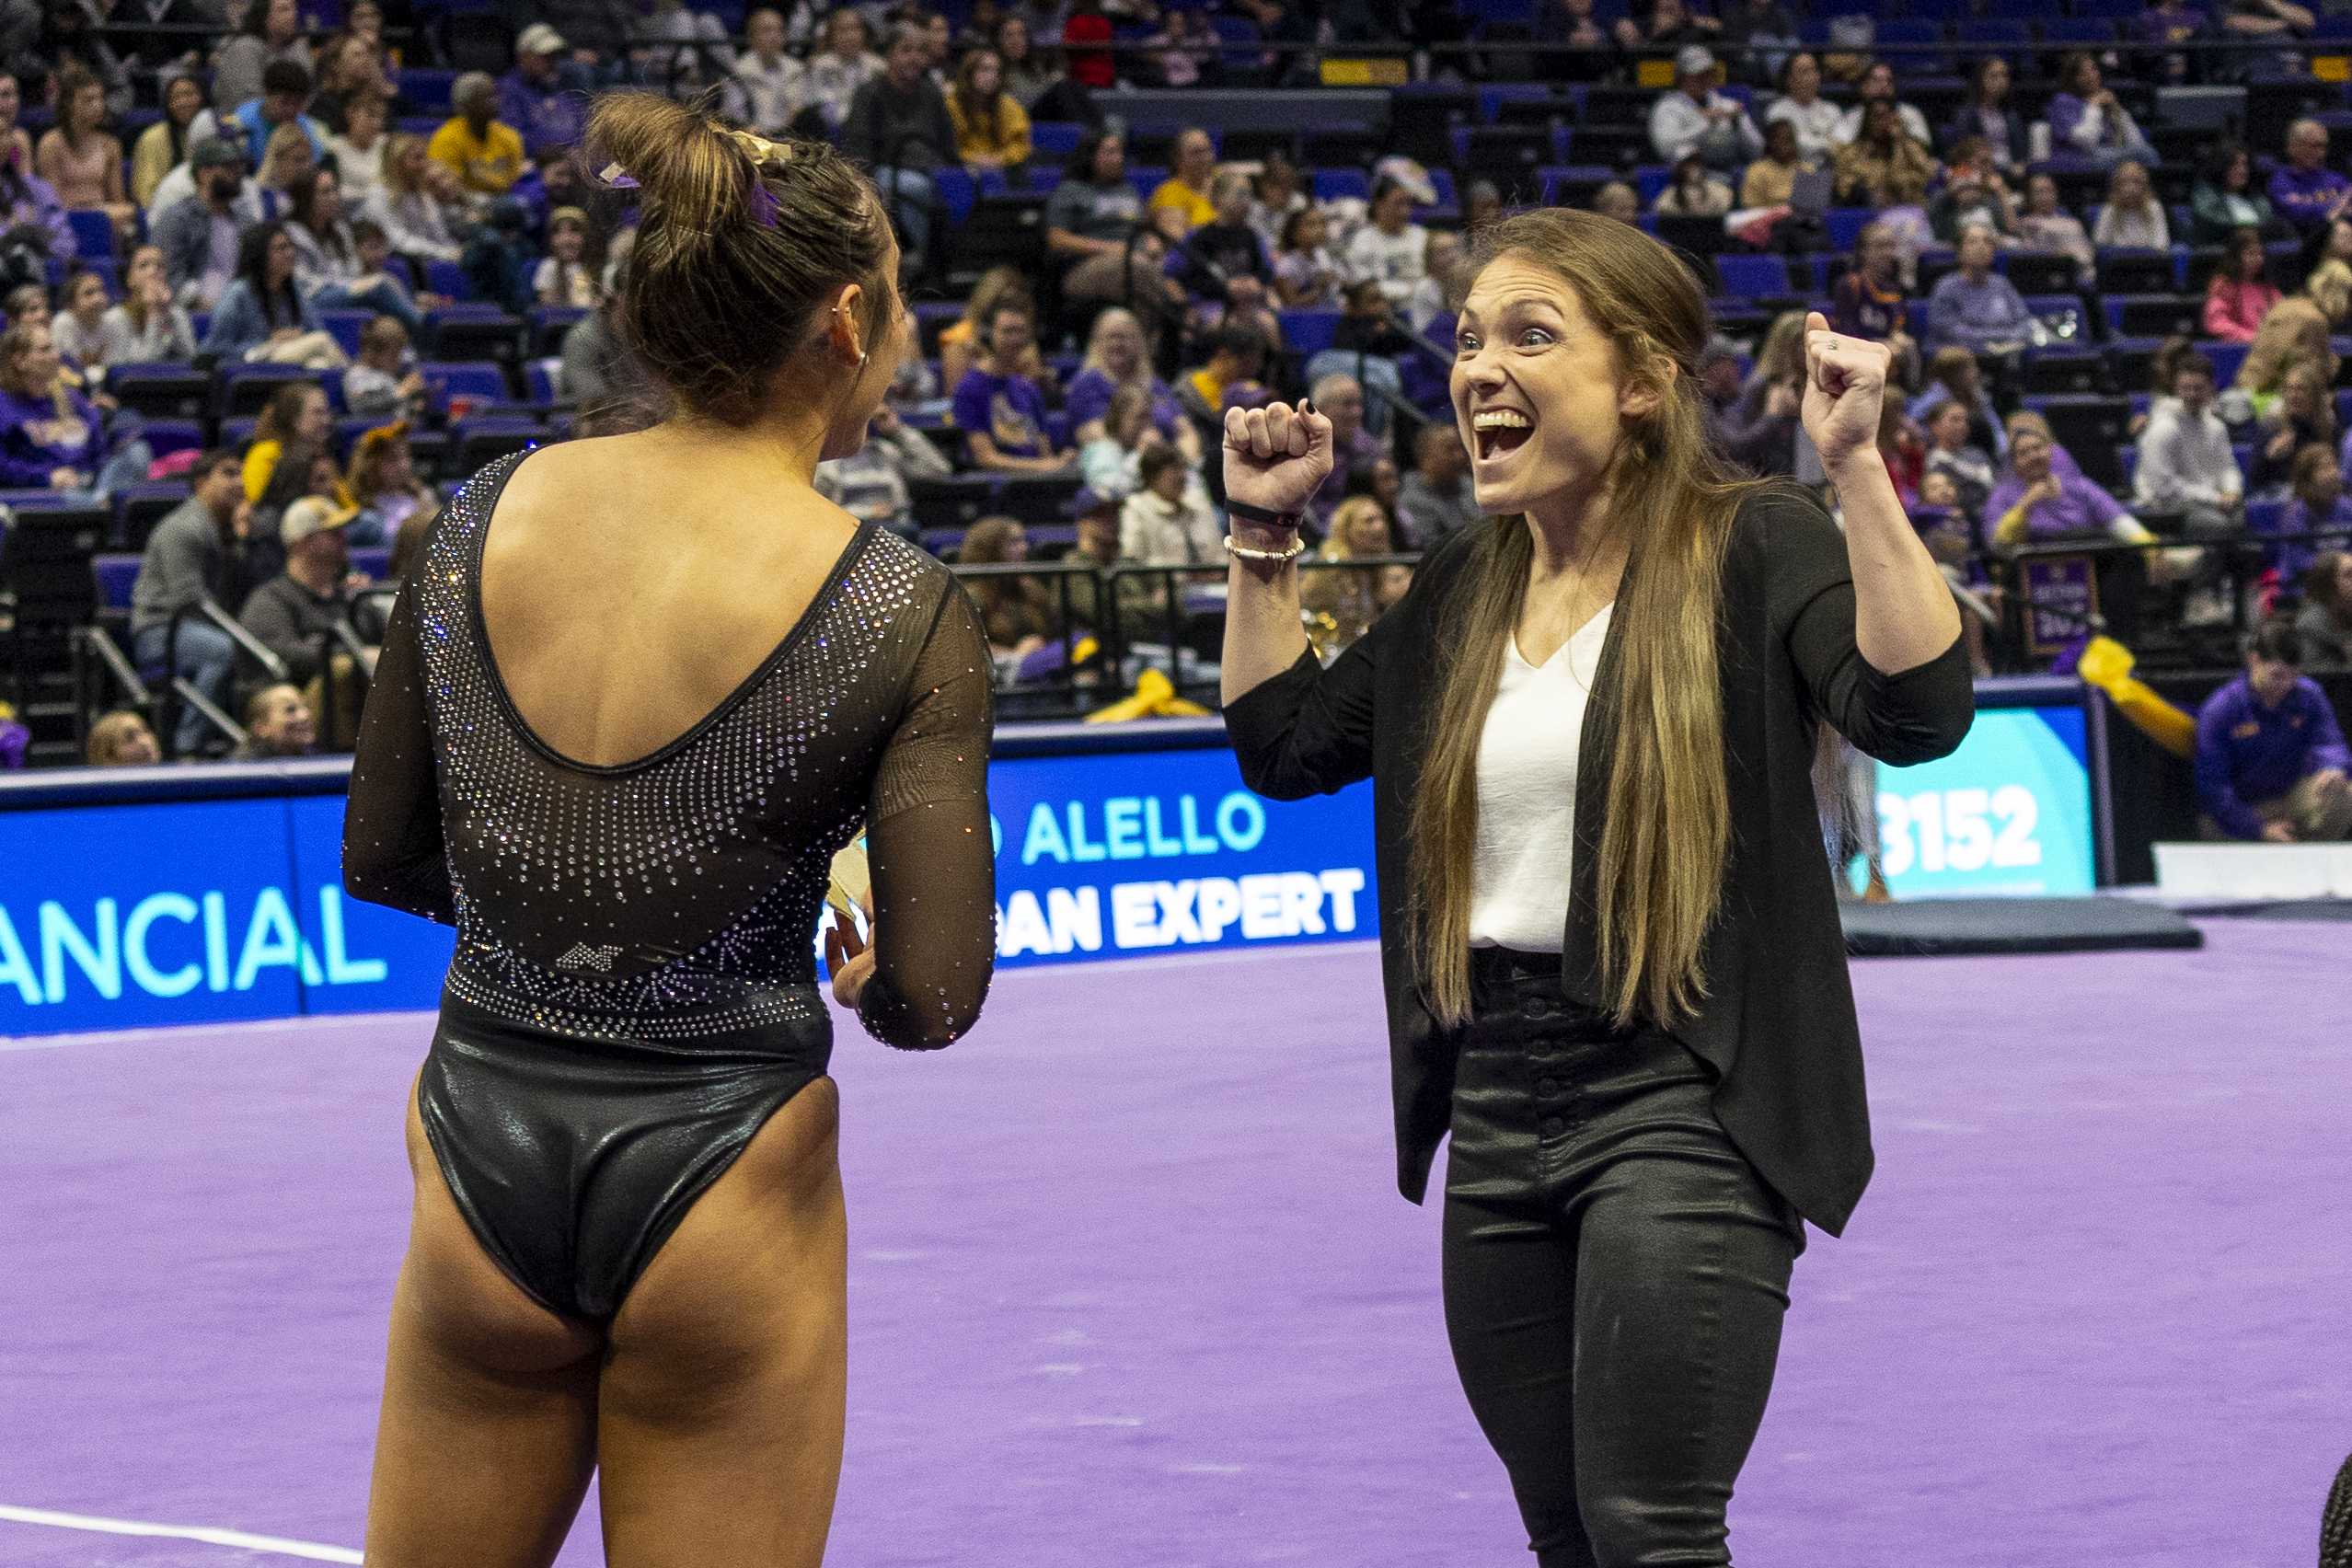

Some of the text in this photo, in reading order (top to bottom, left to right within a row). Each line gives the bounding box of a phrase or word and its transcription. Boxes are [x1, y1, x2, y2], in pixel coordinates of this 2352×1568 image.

[1022, 790, 1266, 865] ALELLO
[1877, 785, 2041, 875] 3152
[996, 869, 1365, 957] AN EXPERT
